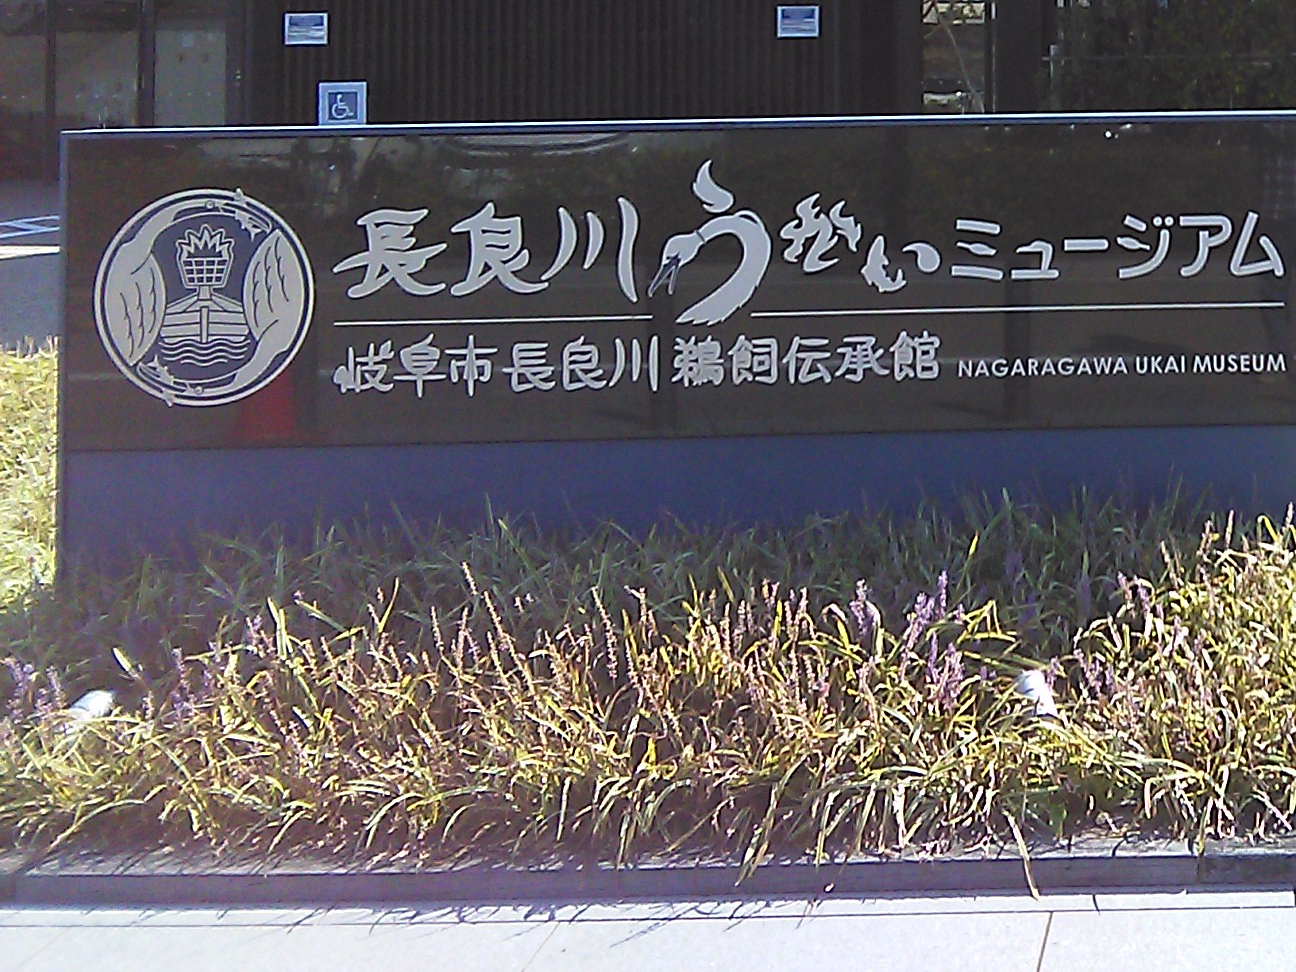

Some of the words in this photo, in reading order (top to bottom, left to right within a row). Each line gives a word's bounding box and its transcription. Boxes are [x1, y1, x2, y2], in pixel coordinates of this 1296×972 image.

[332, 330, 941, 398] 岐阜市長良川鵜飼伝承館
[957, 357, 1128, 379] NAGARAGAWA
[1135, 355, 1186, 375] UKAI
[1192, 353, 1287, 374] MUSEUM
